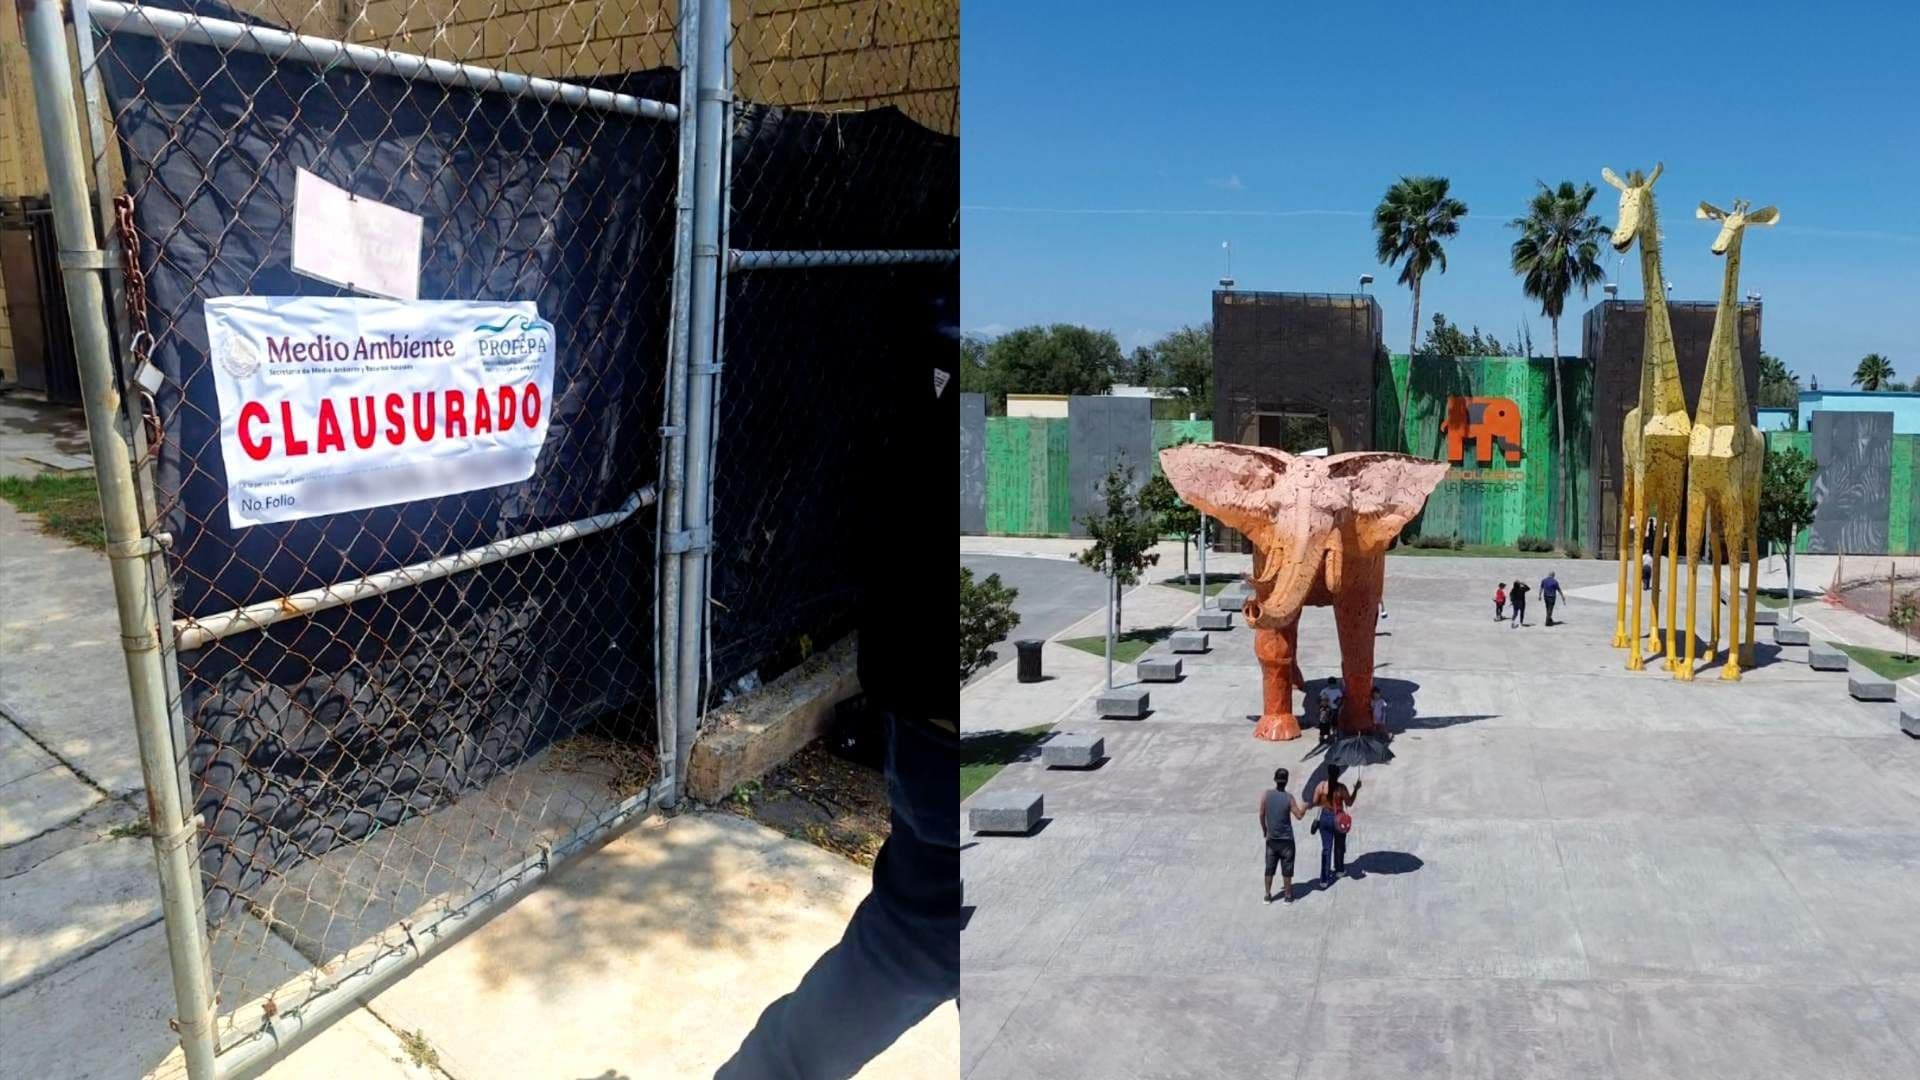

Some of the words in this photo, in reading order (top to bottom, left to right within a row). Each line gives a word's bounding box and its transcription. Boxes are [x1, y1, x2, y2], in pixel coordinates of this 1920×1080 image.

[266, 334, 350, 363] Medio
[353, 333, 456, 361] Ambiente
[479, 337, 547, 356] PROFEPA
[238, 382, 542, 461] CLAUSURADO
[265, 494, 296, 510] Folio
